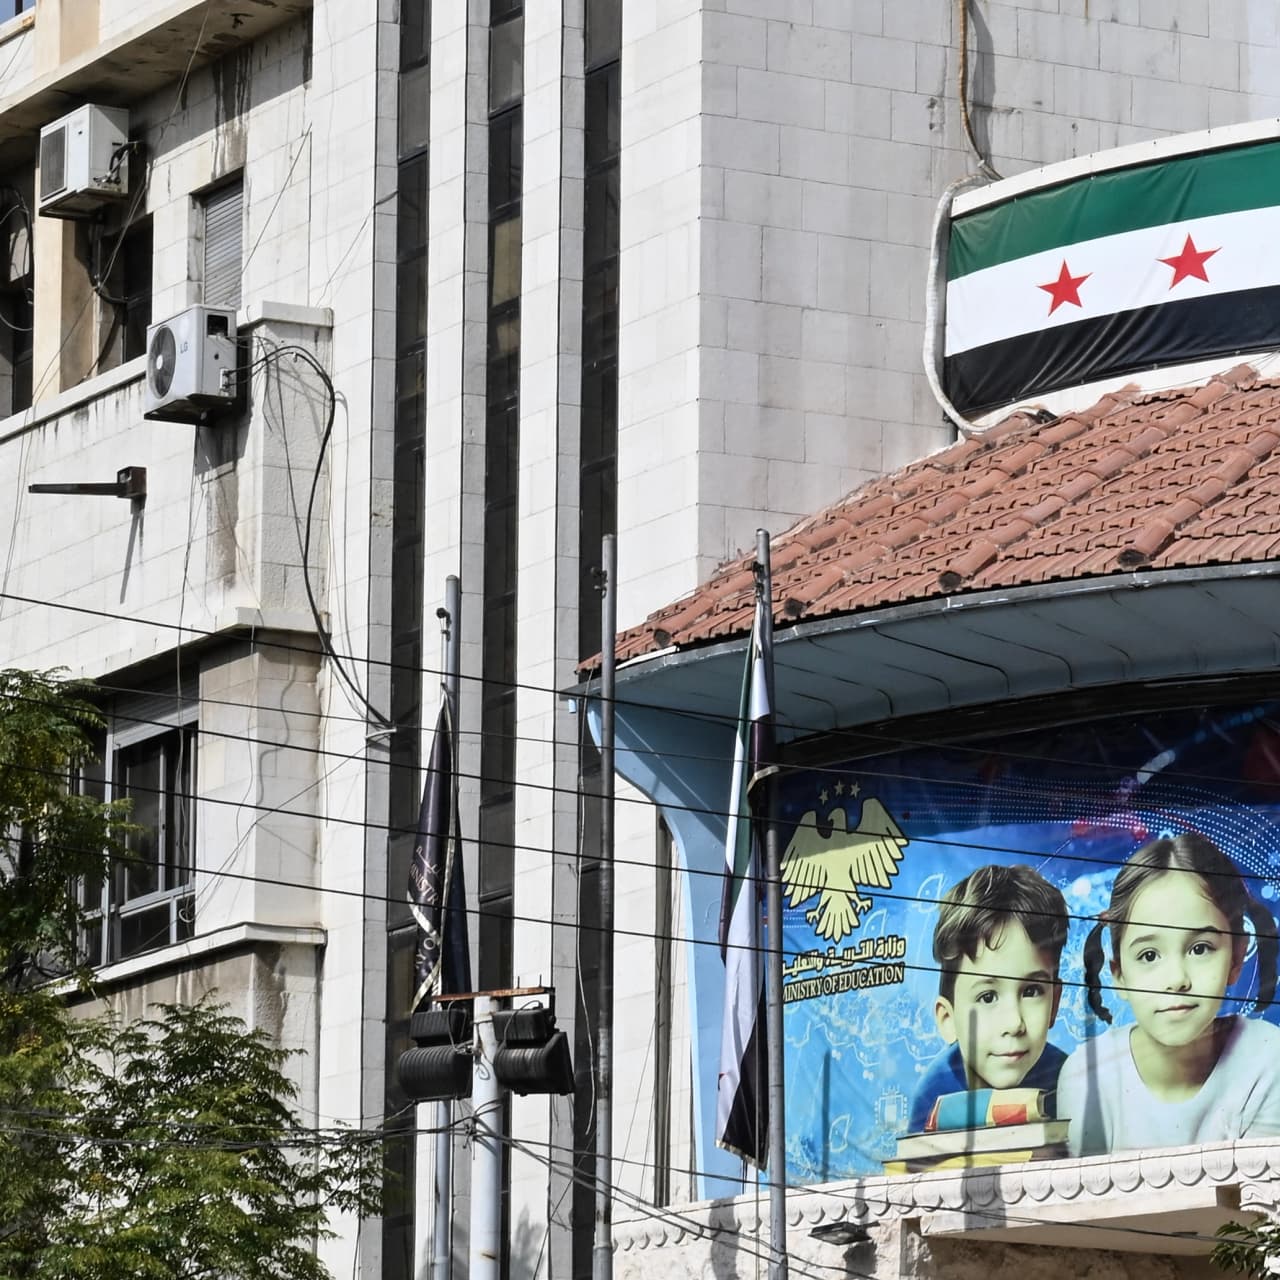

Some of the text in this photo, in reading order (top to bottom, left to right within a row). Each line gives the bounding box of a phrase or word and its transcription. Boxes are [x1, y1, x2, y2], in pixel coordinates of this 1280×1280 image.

[179, 341, 190, 354] LG
[875, 936, 905, 960] وزارة
[783, 950, 824, 976] والتعلي
[823, 975, 839, 994] OF
[839, 965, 904, 991] EDUCATION
